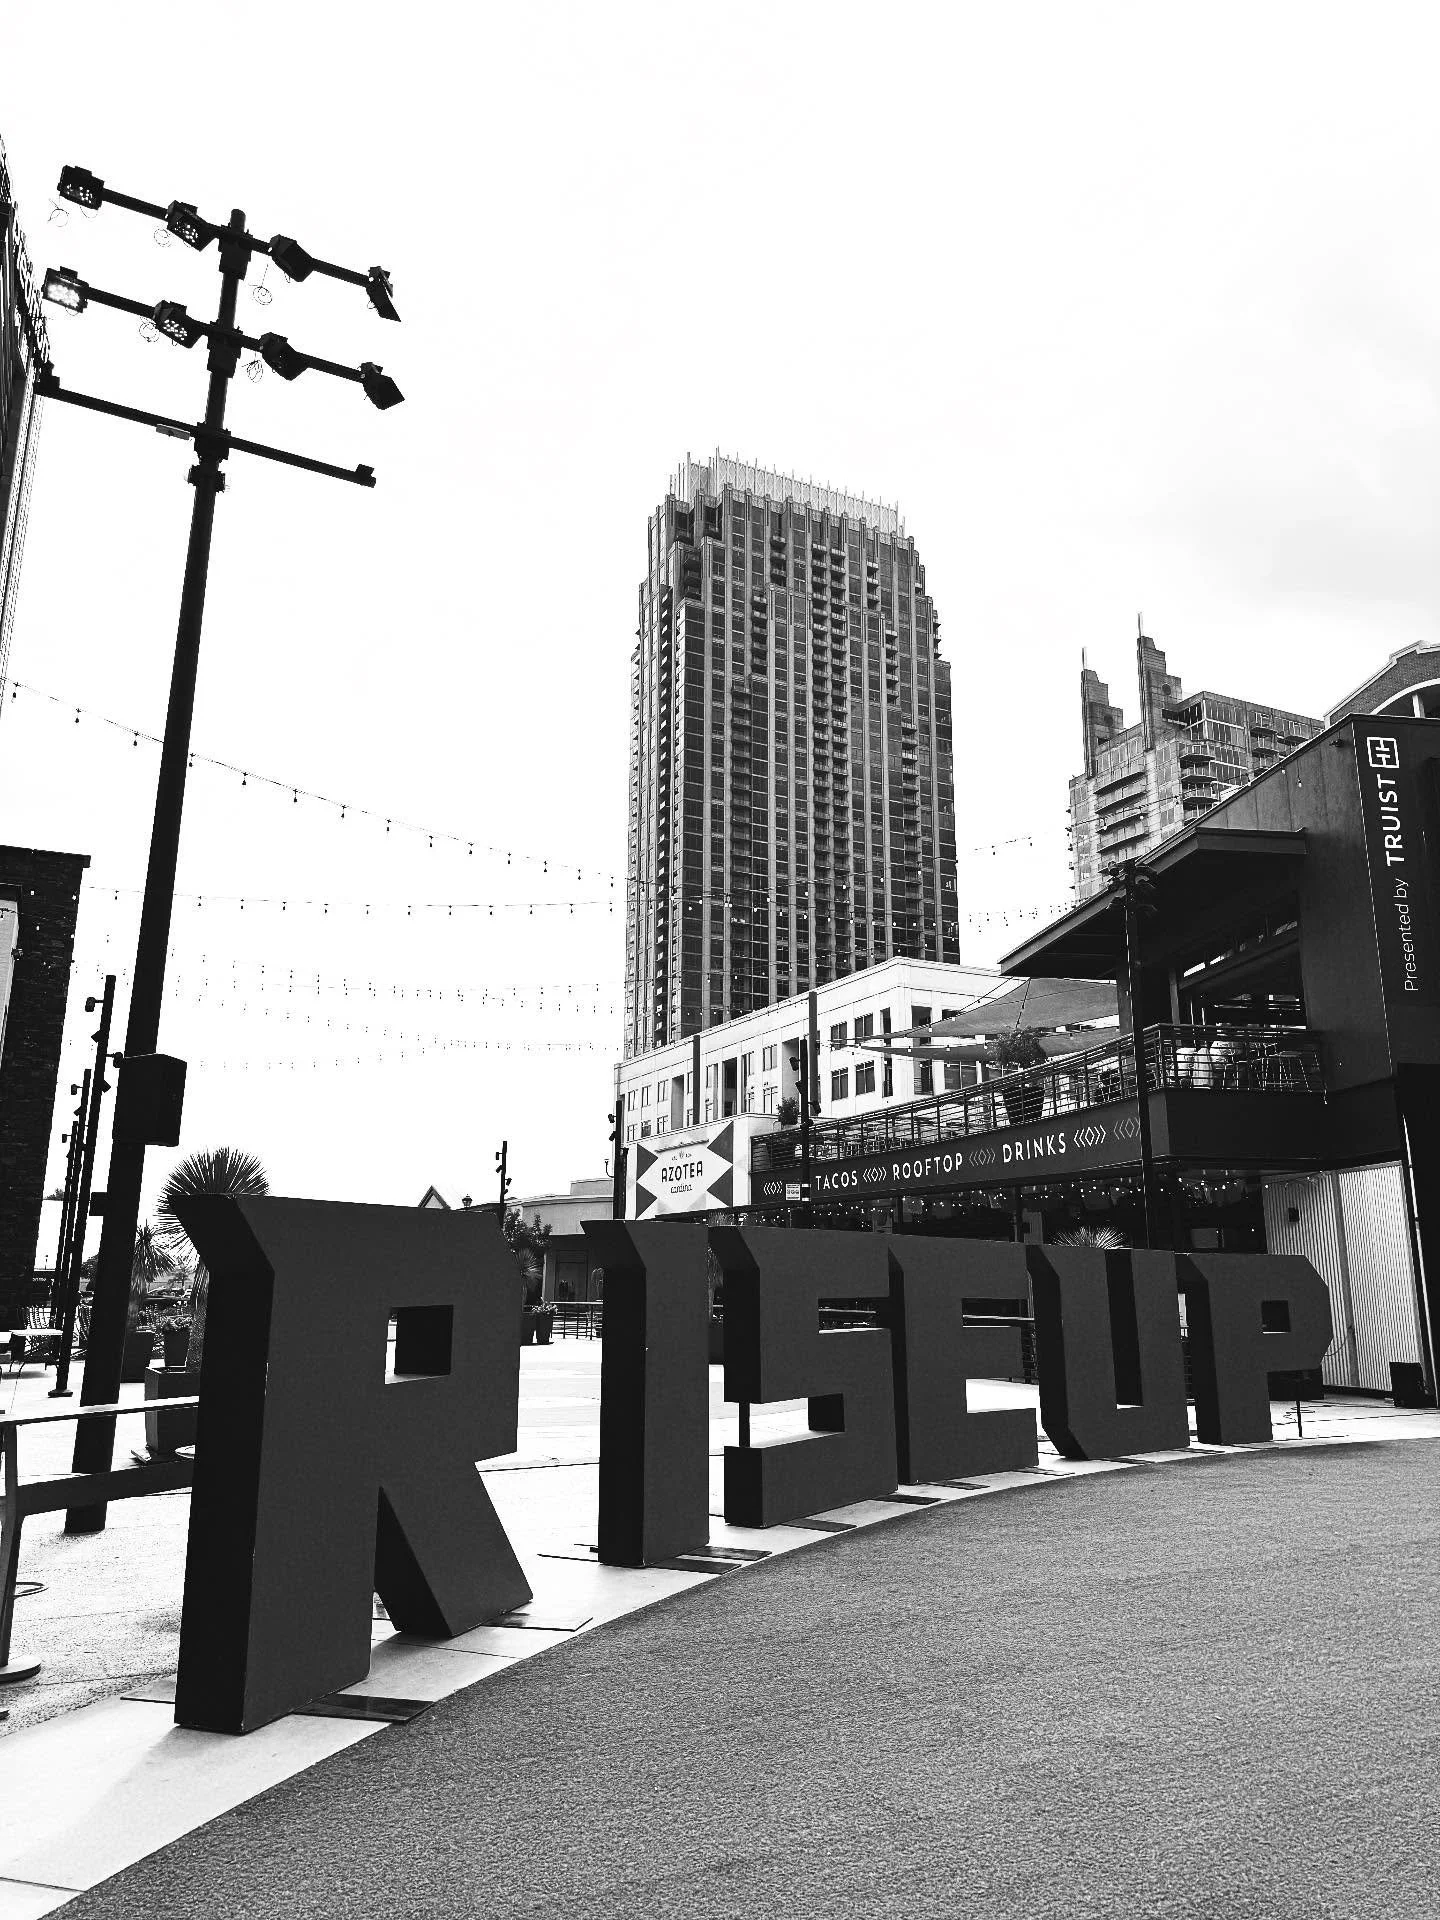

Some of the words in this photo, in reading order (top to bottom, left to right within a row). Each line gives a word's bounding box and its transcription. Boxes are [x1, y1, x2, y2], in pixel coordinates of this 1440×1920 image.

[1377, 774, 1405, 867] TRUIST
[1392, 878, 1409, 899] by
[1397, 904, 1418, 991] Presented
[661, 1160, 703, 1183] AZOTEA
[816, 1171, 858, 1191] TACOS
[893, 1152, 963, 1181] ROOFTOP
[1003, 1132, 1066, 1164] DRINKS
